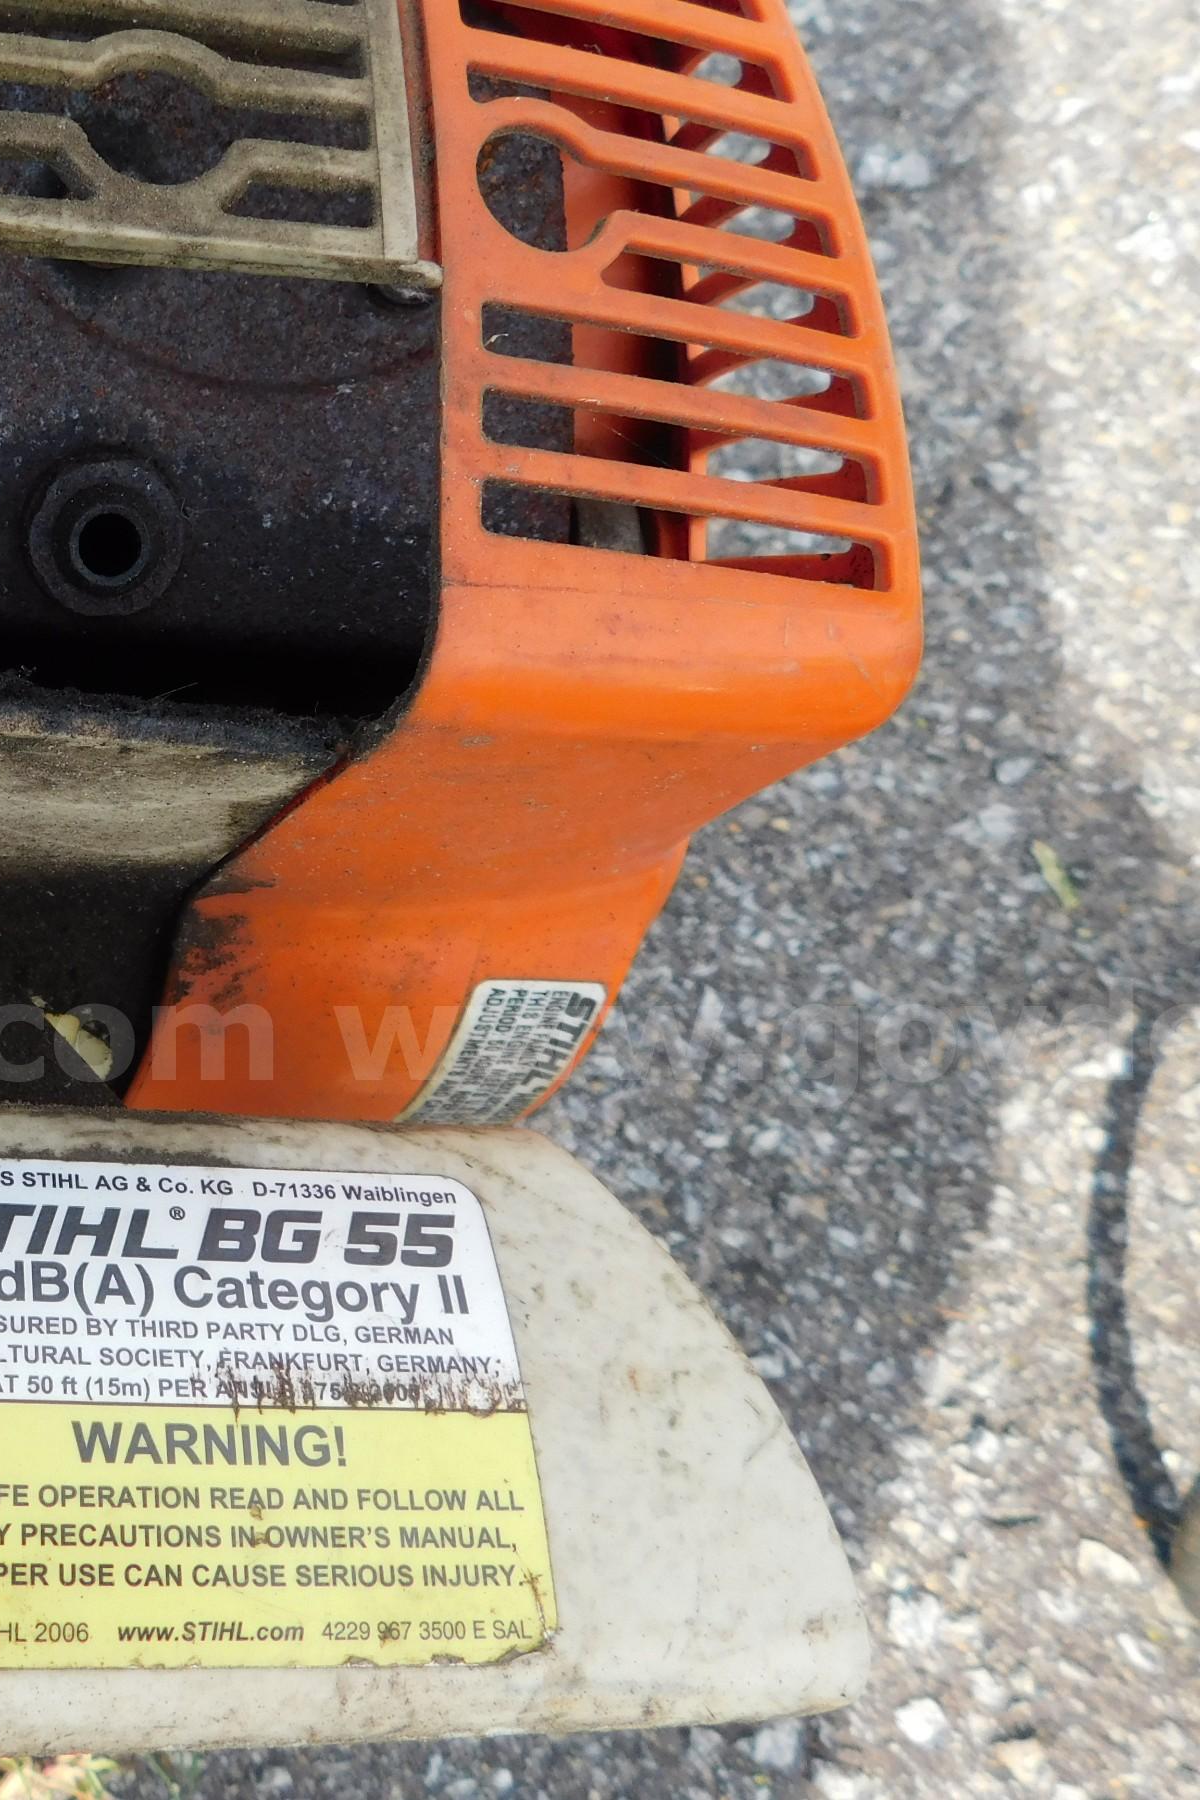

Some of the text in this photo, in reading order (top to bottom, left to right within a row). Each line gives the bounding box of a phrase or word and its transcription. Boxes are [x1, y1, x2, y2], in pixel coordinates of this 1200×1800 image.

[521, 990, 550, 1019] THIS
[537, 990, 569, 1029] ENGINE
[448, 988, 506, 1076] ADJUSTMENTS
[497, 1025, 532, 1064] ENGINE
[520, 992, 596, 1085] STIHL
[22, 1170, 88, 1191] STIHL
[95, 1174, 128, 1194] AG
[135, 1175, 150, 1194] &
[158, 1176, 195, 1195] Co.
[200, 1178, 233, 1197] KG
[252, 1181, 336, 1200] D-71336
[342, 1183, 457, 1206] Waiblingen
[198, 1206, 323, 1264] BG
[343, 1213, 456, 1268] 55
[174, 1265, 419, 1325] Category
[438, 1275, 470, 1315] II
[86, 1317, 117, 1337] BY
[125, 1319, 199, 1340] THIRD
[207, 1321, 286, 1342] PARTY
[293, 1324, 347, 1345] DLG,
[355, 1324, 455, 1346] GERMAN
[100, 1345, 212, 1372] SOCIETY,
[26, 1374, 54, 1395] 50
[61, 1375, 79, 1396] ft
[86, 1375, 151, 1401] (15m)
[158, 1377, 208, 1399] PER
[71, 1420, 347, 1468] WARNING!
[38, 1484, 199, 1510] OPERATION
[209, 1486, 285, 1511] READ
[293, 1488, 350, 1511] AND
[356, 1488, 467, 1512] FOLLOW
[475, 1489, 525, 1512] ALL
[20, 1523, 222, 1549] PRECAUTIONS
[230, 1525, 253, 1549] IN
[265, 1525, 390, 1550] OWNER'S
[59, 1562, 115, 1587] USE
[124, 1563, 183, 1587] CAN
[191, 1563, 287, 1587] CAUSE
[295, 1563, 415, 1587] SERIOUS
[421, 1563, 524, 1587] INJURY.
[34, 1622, 88, 1643] 2006
[118, 1618, 305, 1642] www.STIHL.com
[321, 1622, 371, 1641] 4229
[419, 1619, 467, 1641] 3500
[473, 1619, 486, 1641] E
[492, 1619, 533, 1641] SAL
